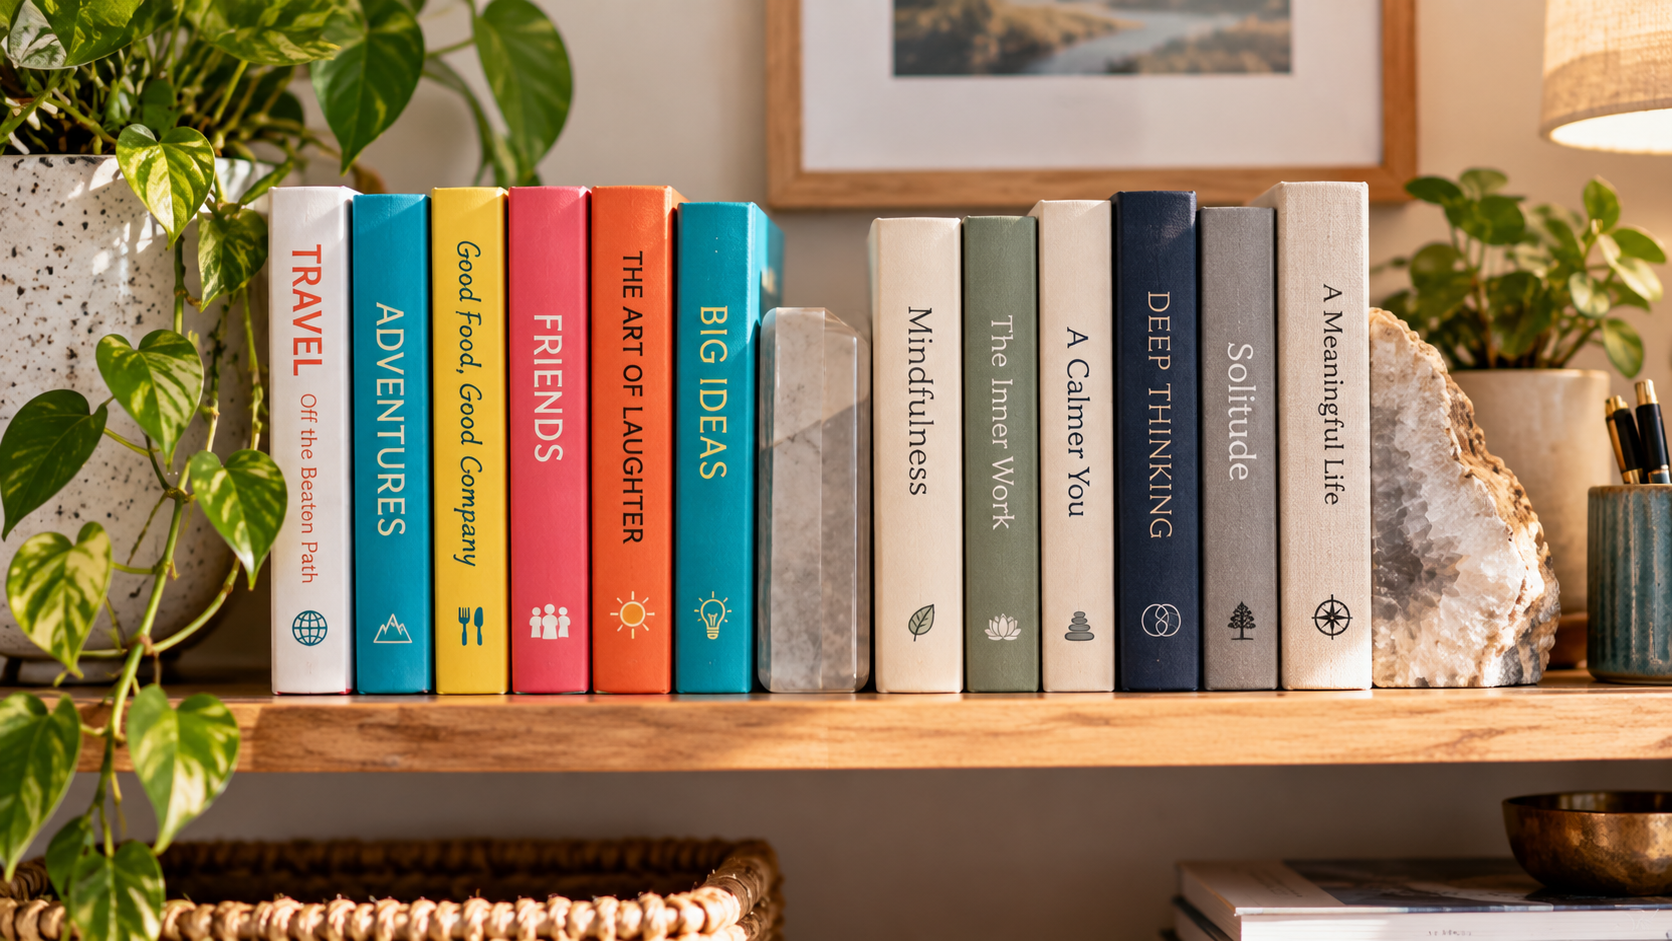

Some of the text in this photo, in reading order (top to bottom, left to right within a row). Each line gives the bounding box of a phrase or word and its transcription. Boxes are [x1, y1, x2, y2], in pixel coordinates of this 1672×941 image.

[292, 244, 322, 376] TRAVEL
[453, 241, 483, 566] Good Food, Good Company
[534, 315, 563, 462] FRIENDS
[623, 251, 643, 544] THE ART OF LAUGHTER
[700, 306, 727, 479] BIG IDEAS
[909, 307, 934, 495] Mindfulness
[1318, 284, 1345, 505] A Meaningful Life
[301, 394, 317, 423] Off
[301, 429, 317, 459] the
[377, 302, 405, 536] ADVENTURES
[991, 315, 1014, 529] The Inner Work
[1067, 327, 1090, 517] A Calmer You
[1148, 292, 1172, 538] DEEP THINKING
[1228, 342, 1257, 481] Solitude
[302, 542, 318, 583] Path
